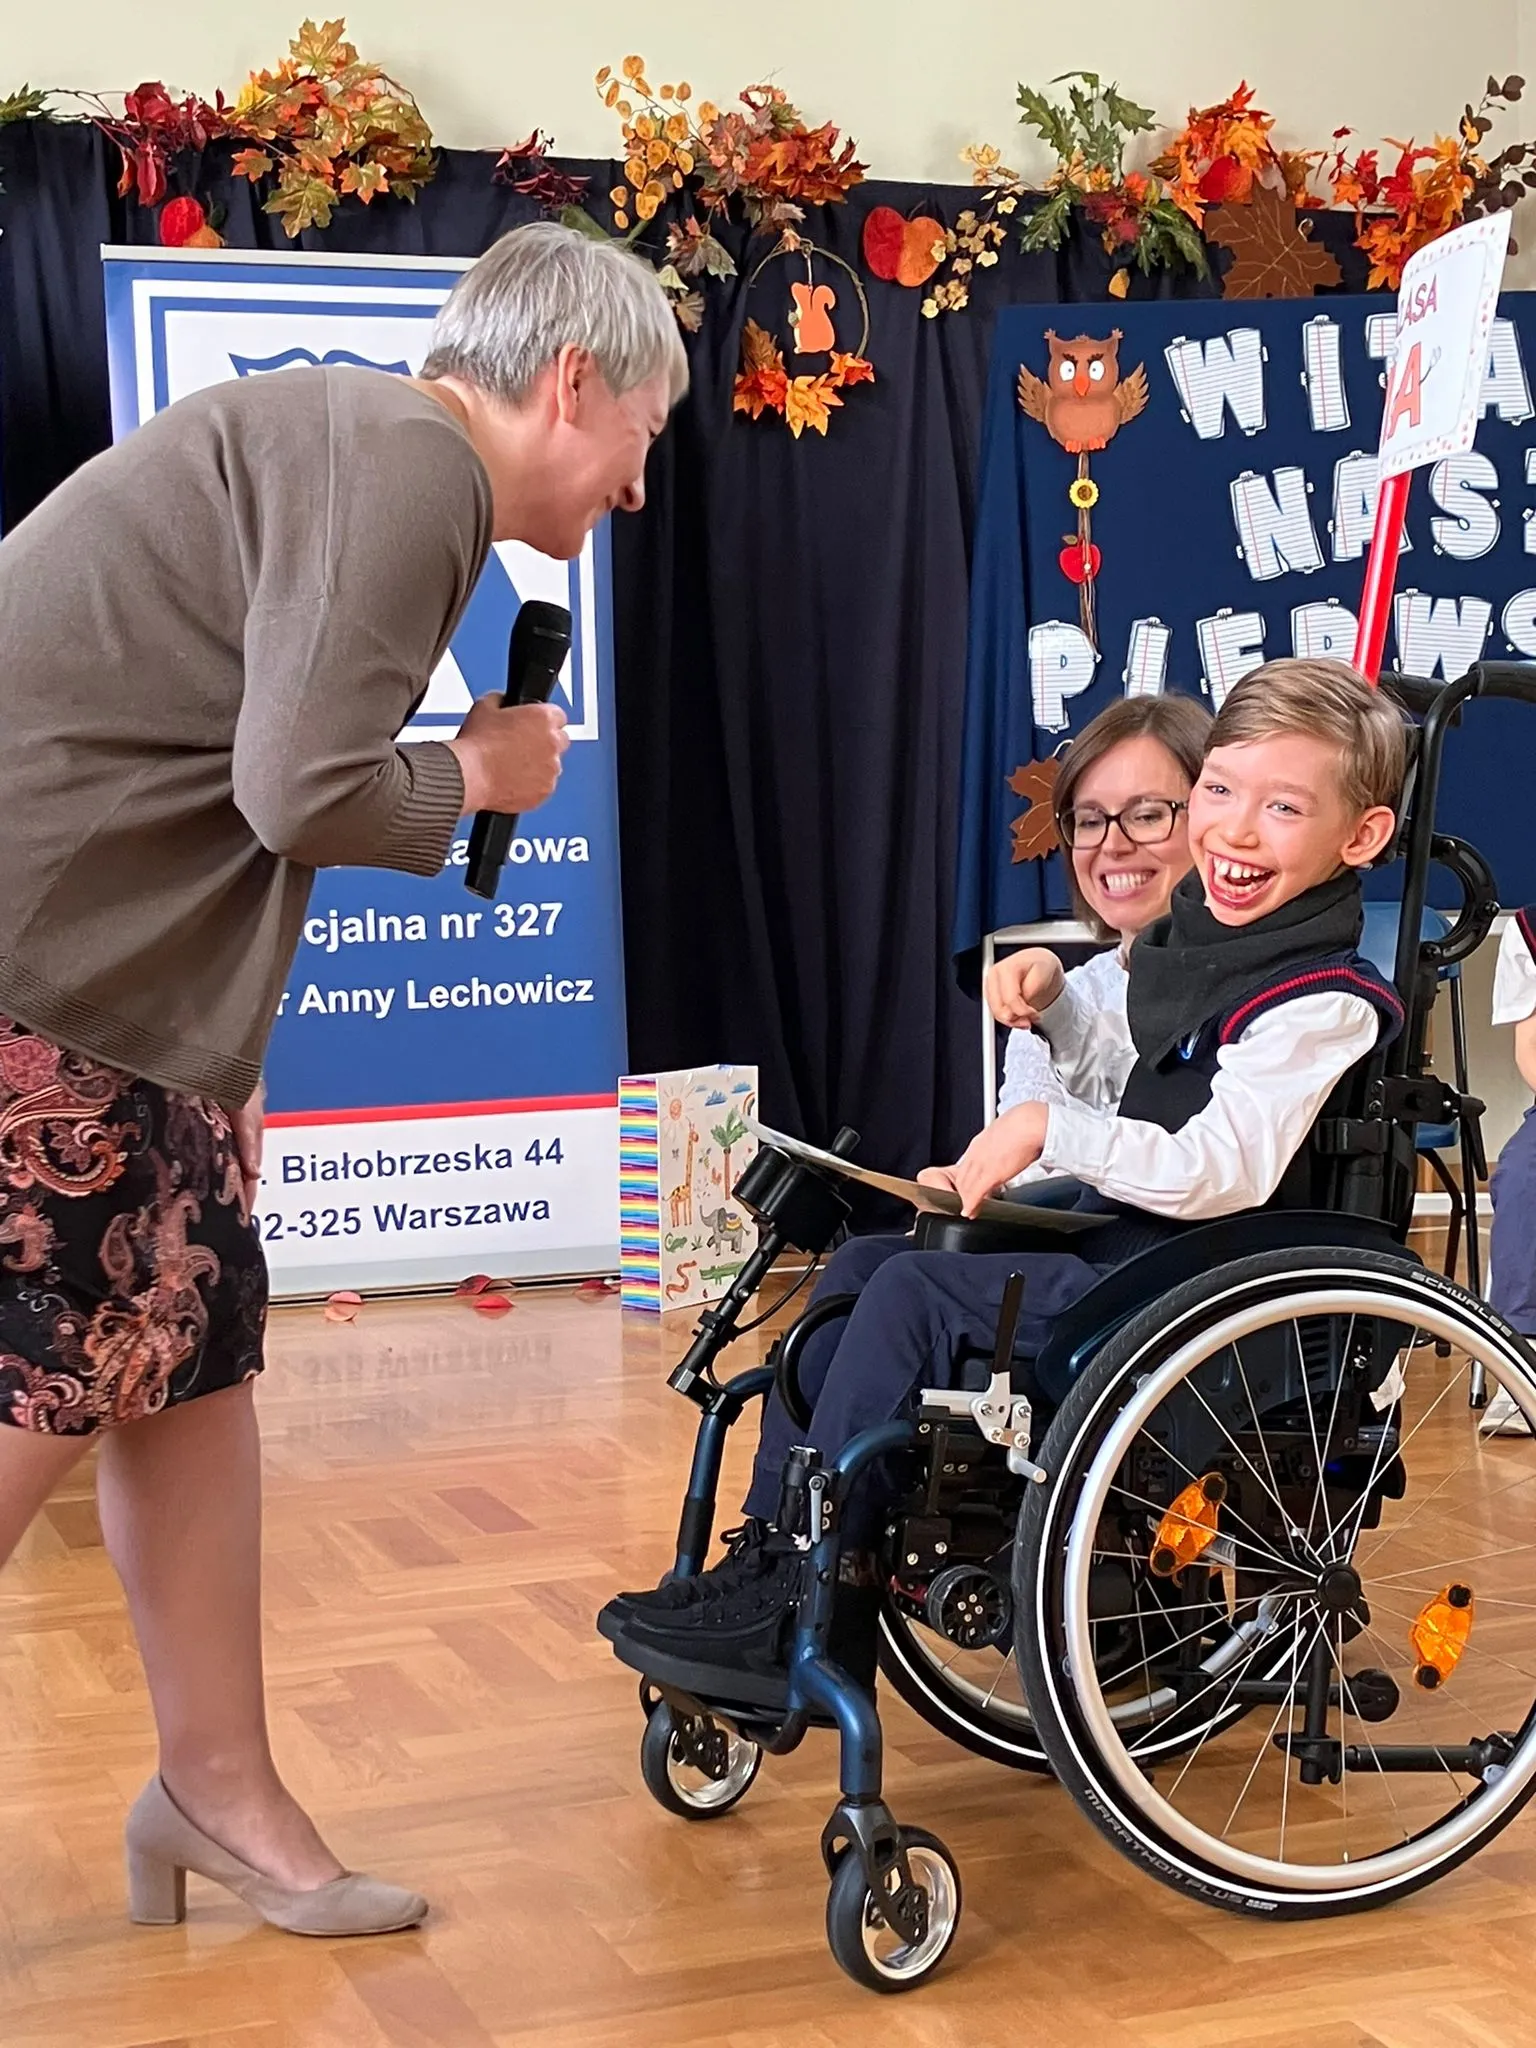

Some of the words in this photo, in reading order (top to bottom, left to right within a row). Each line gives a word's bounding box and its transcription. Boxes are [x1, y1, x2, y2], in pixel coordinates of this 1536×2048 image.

[1229, 449, 1536, 581] NAS
[303, 908, 427, 953] cjalna
[440, 912, 482, 939] nr
[494, 902, 563, 938] 327
[298, 983, 395, 1019] Anny
[407, 974, 594, 1010] Lechowicz
[283, 1143, 513, 1184] Białobrzeska
[524, 1137, 565, 1166] 44
[373, 1198, 551, 1233] Warszawa
[1410, 1271, 1513, 1338] SCHWALBE
[1185, 1879, 1244, 1905] PLUS
